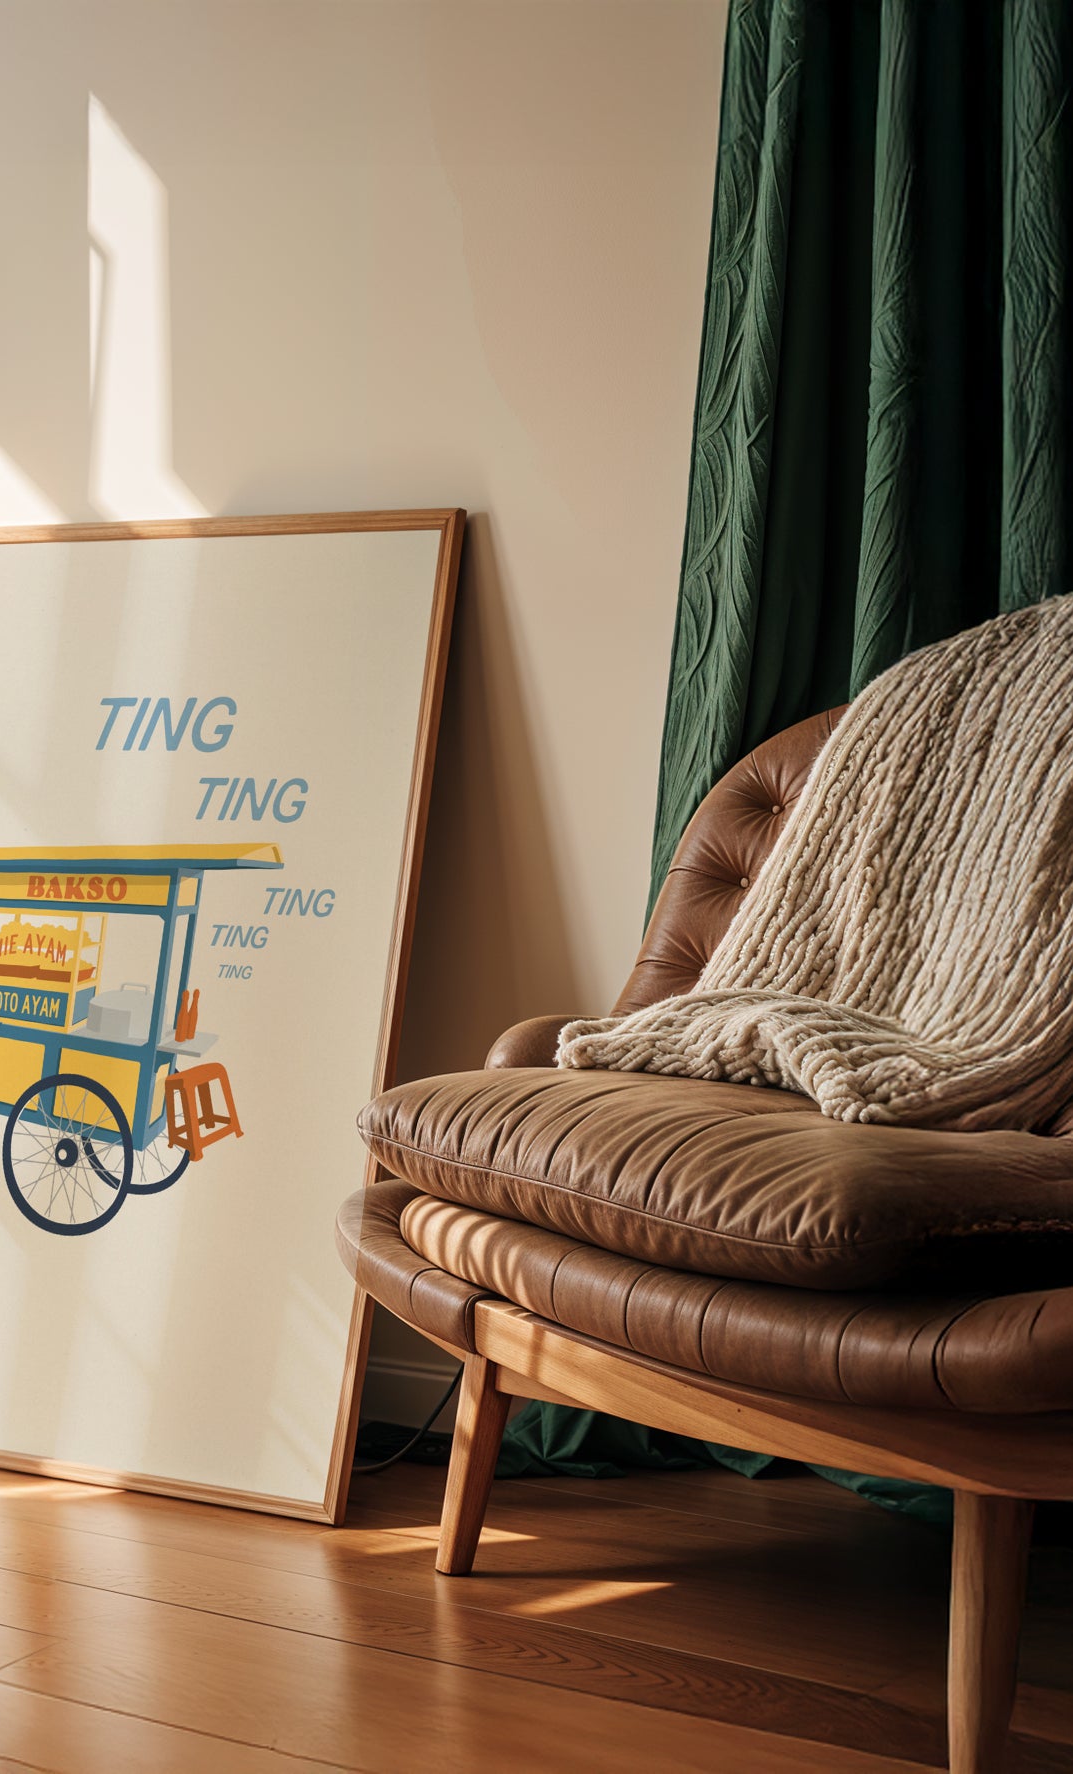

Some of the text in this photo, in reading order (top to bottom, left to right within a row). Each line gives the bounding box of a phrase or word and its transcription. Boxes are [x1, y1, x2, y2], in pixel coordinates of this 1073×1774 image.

[95, 696, 238, 753] TING
[195, 777, 309, 824] TING
[26, 875, 128, 902] BAKSO
[263, 887, 336, 918] TING
[22, 933, 68, 967] AYAM
[210, 924, 269, 949] TING
[218, 964, 253, 980] TING
[21, 994, 61, 1019] AYAM
